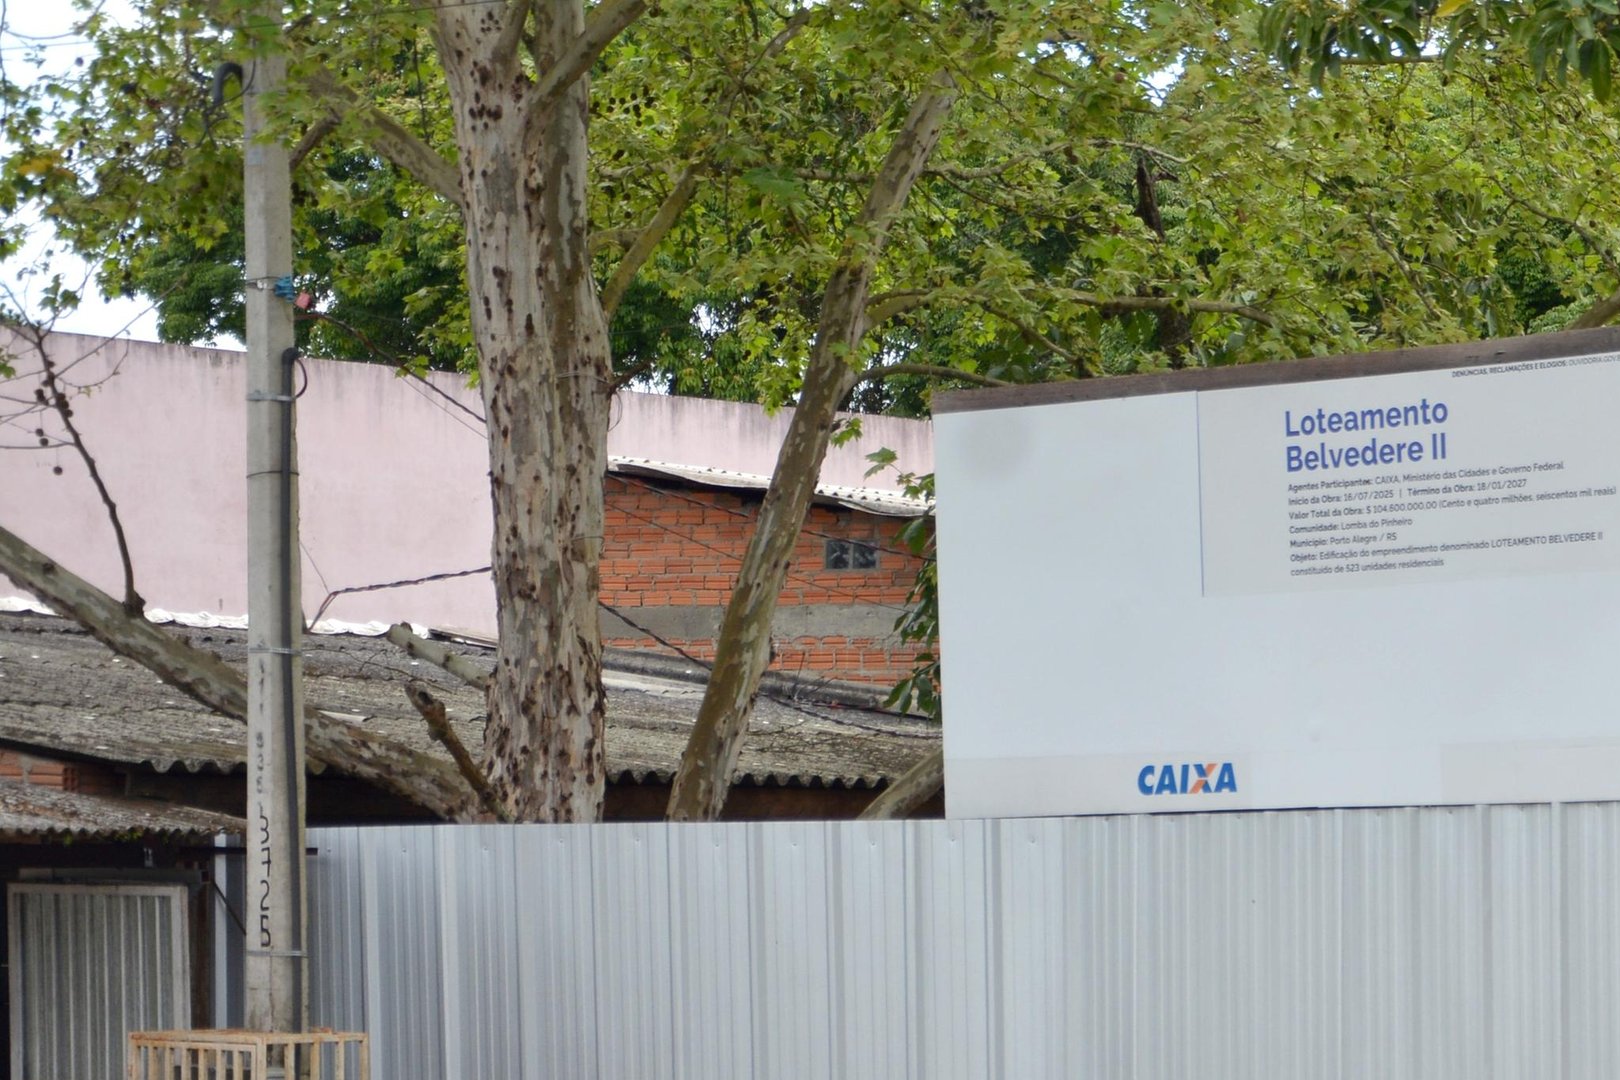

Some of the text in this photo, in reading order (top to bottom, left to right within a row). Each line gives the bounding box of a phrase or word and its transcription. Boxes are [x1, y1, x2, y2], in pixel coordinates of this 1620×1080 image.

[1285, 398, 1448, 437] Loteamento
[1286, 432, 1447, 473] Belvedere II
[1288, 481, 1319, 494] Agentes
[1320, 476, 1372, 491] Participantes:
[1402, 471, 1440, 482] Ministério
[1442, 469, 1456, 479] das
[1458, 467, 1490, 478] Cidades
[1498, 463, 1531, 475] Governo
[1533, 461, 1564, 472] Federal
[1288, 495, 1309, 506] Início
[1310, 494, 1320, 504] da
[1321, 493, 1342, 503] Obra:
[1407, 485, 1440, 496] Término
[1442, 484, 1452, 494] da
[1454, 483, 1475, 493] Obra:
[1477, 479, 1527, 491] 18/01/2027
[1288, 509, 1309, 520] Valor
[1310, 508, 1330, 518] Total
[1332, 507, 1342, 516] da
[1343, 505, 1364, 515] Obra:
[1466, 498, 1472, 506] e
[1473, 494, 1500, 507] quatro
[1536, 488, 1577, 500] seiscentos
[1579, 487, 1592, 497] mil
[1289, 517, 1413, 534] Comunidade: Lomba do Pinheiro
[1290, 532, 1397, 550] Município: Porto Alegre RS
[1290, 552, 1317, 564] Objeto:
[1319, 549, 1358, 562] Edificação
[1371, 543, 1438, 559] empreendimento
[1440, 540, 1490, 552] denominado
[1491, 536, 1547, 548] LOTEAMENTO
[1549, 532, 1596, 544] BELVEDERE
[1290, 557, 1444, 576] constituído de 523 unidades residenciais
[1137, 762, 1237, 795] CAIXA
